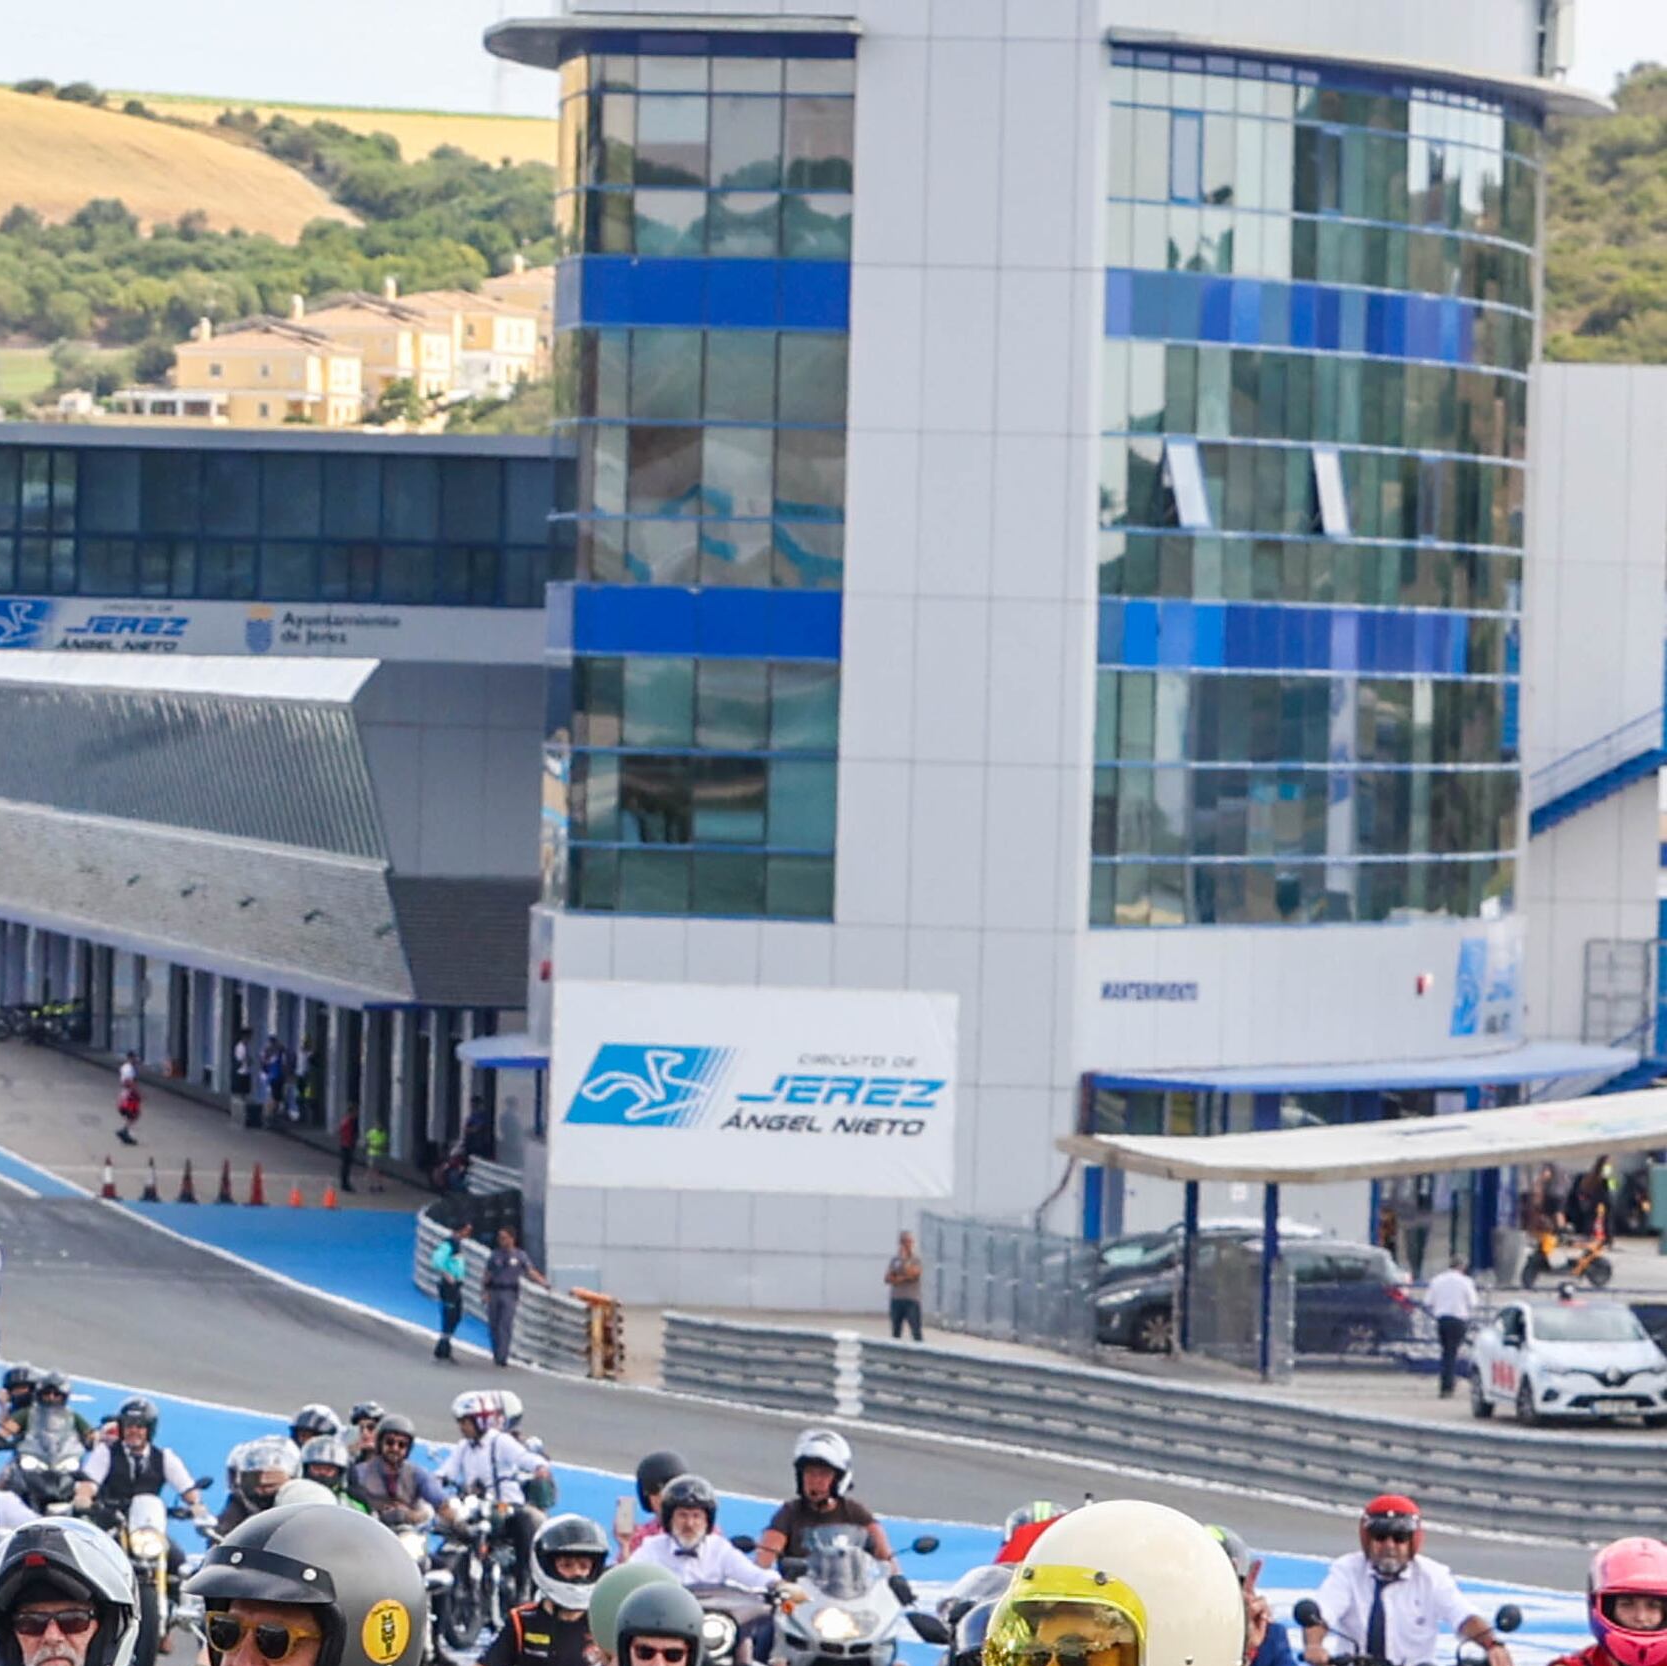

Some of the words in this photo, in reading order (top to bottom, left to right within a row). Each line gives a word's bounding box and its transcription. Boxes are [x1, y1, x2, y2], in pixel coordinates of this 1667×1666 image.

[66, 616, 191, 637] JEREZ
[798, 1053, 886, 1068] CIRCUITO
[892, 1055, 918, 1068] DE
[736, 1074, 947, 1108] JEREZ
[720, 1107, 822, 1133] ÁNGEL
[831, 1115, 926, 1136] NIETO
